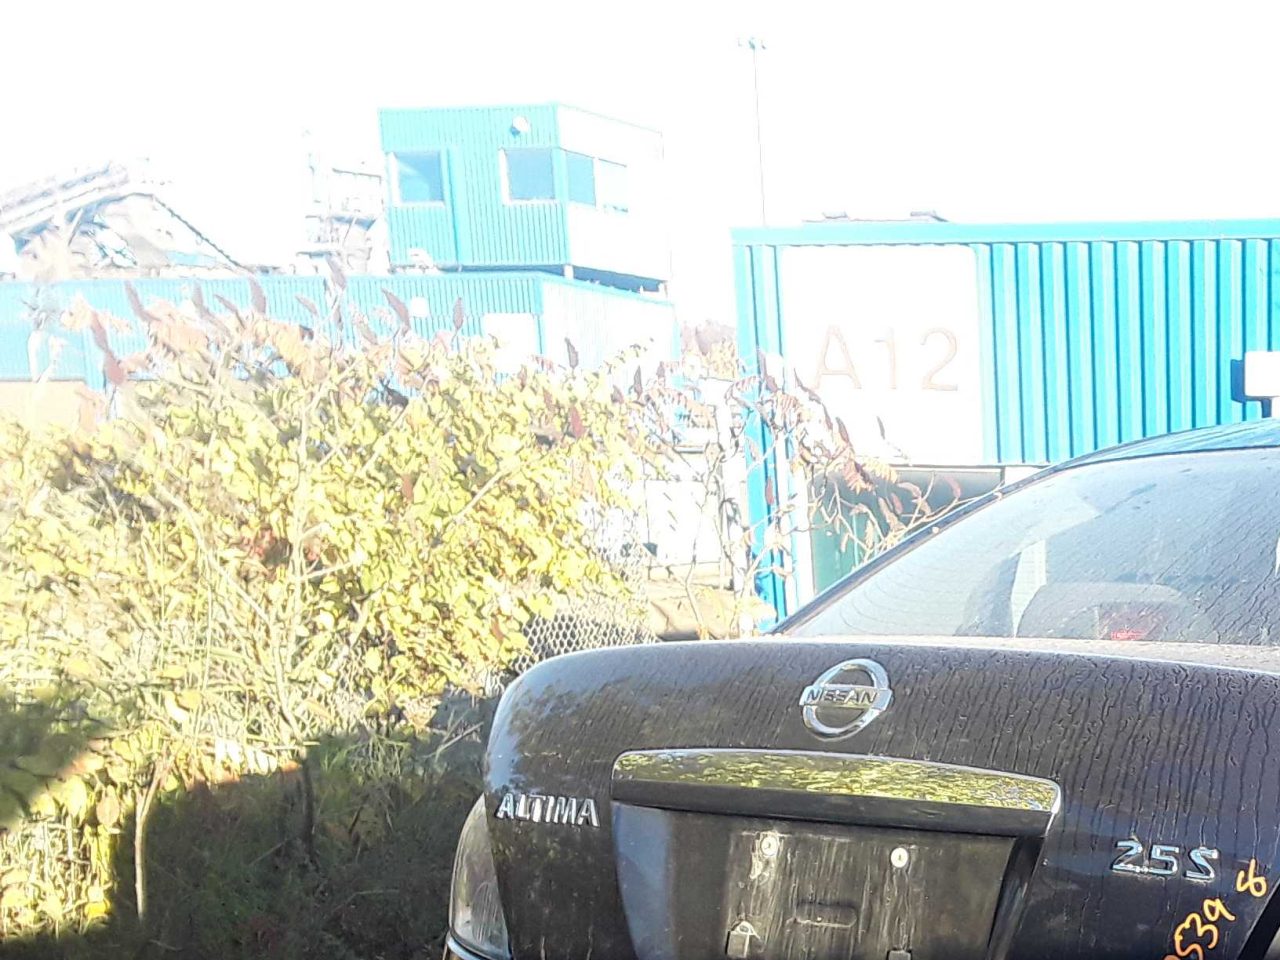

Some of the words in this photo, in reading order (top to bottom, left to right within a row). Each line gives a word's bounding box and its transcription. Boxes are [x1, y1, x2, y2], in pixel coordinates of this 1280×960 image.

[811, 325, 959, 391] A12
[805, 687, 878, 705] NISSAN
[496, 792, 600, 828] ALTIMA
